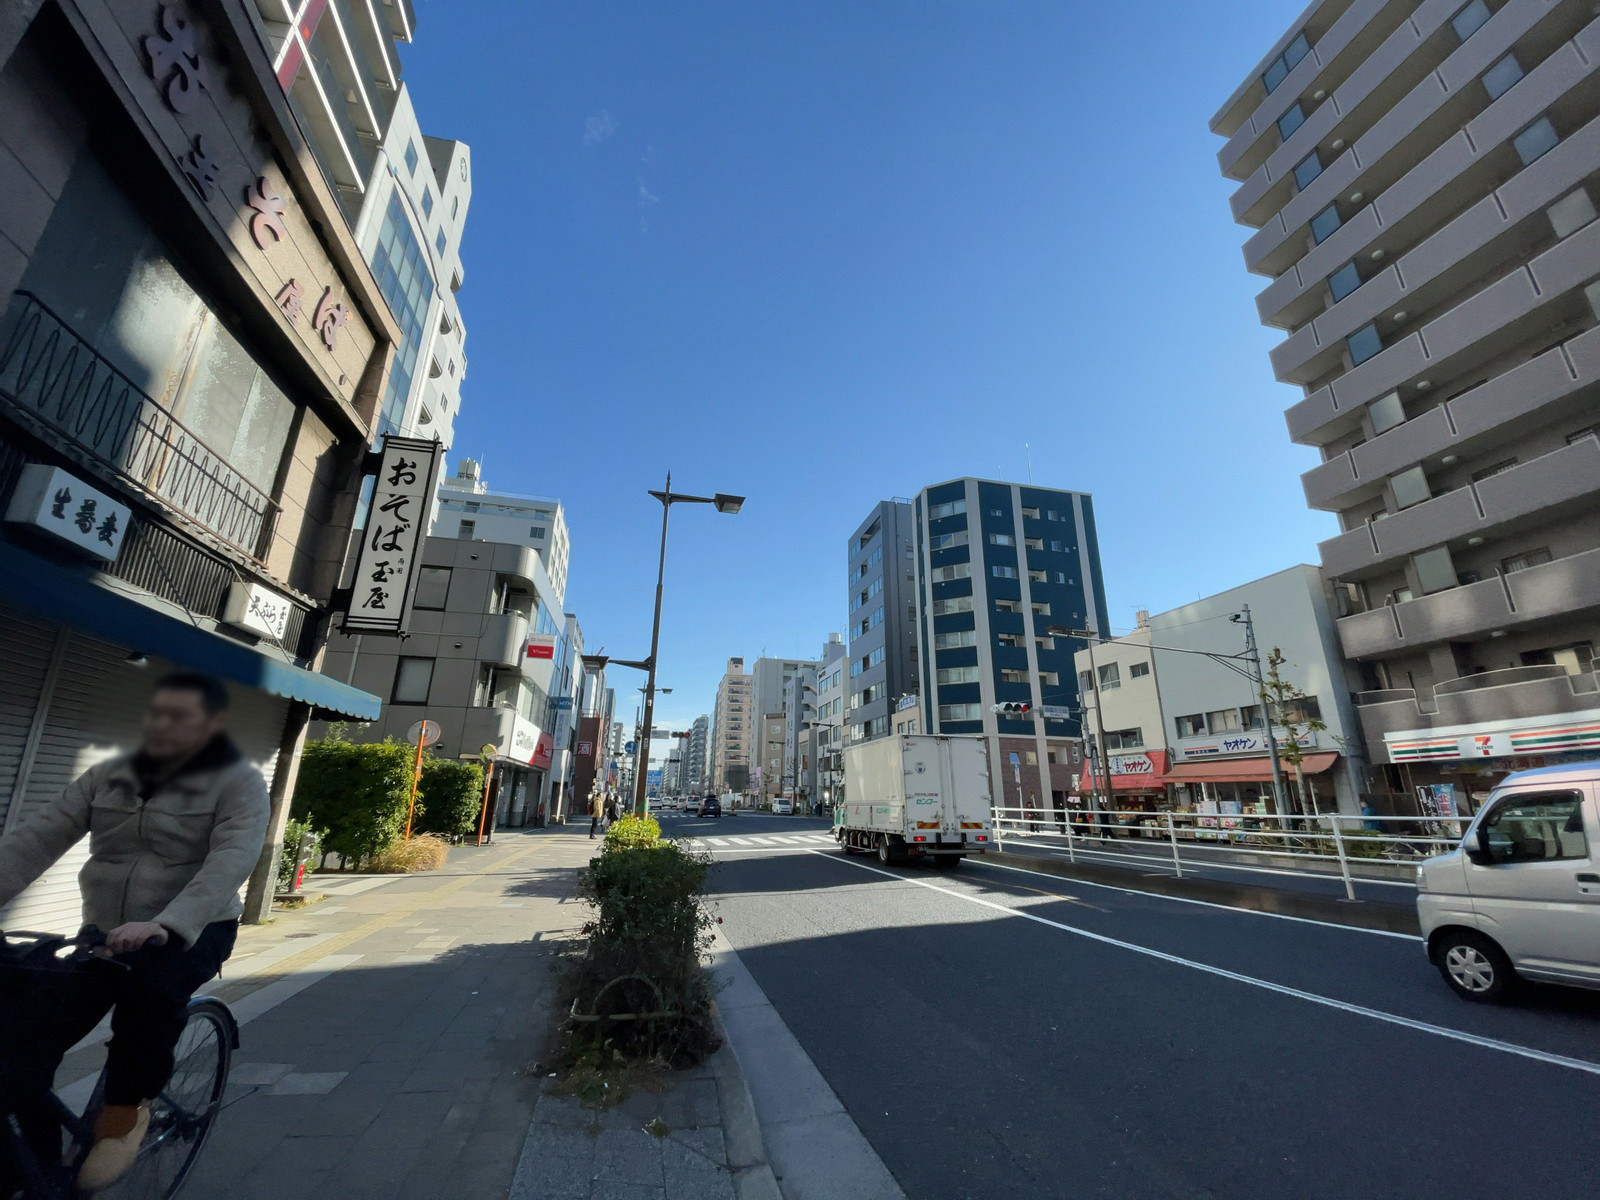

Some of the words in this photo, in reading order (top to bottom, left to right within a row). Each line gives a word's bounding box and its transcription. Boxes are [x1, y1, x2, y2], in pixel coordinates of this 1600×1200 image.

[577, 743, 590, 755] 酒
[1223, 737, 1257, 751] ヤオケン
[1123, 760, 1152, 773] ヤオケン
